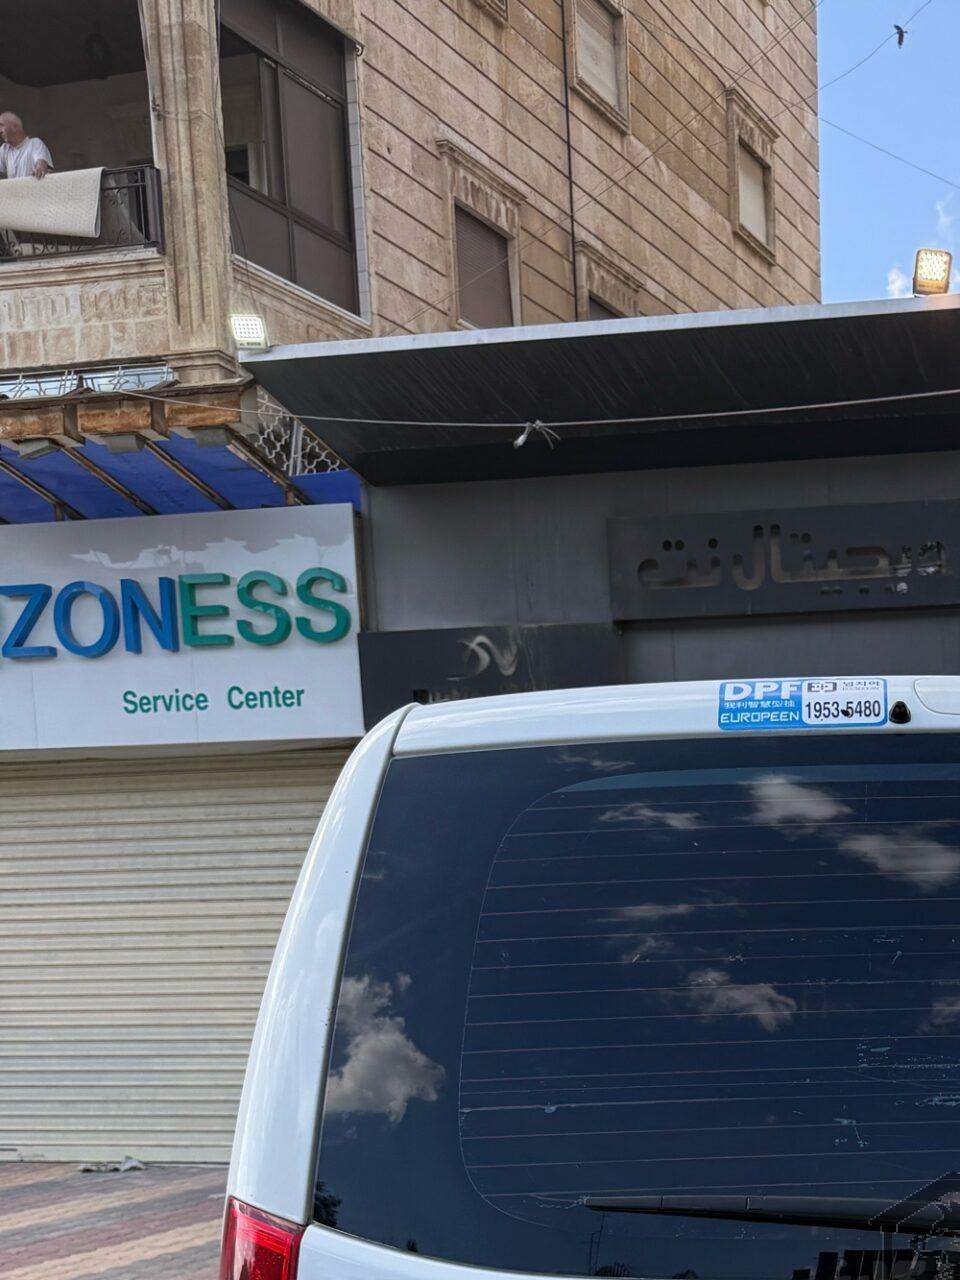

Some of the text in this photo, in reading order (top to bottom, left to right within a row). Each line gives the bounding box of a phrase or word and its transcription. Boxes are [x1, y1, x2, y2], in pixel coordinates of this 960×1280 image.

[0, 566, 351, 661] ZONESS
[122, 685, 305, 714] Service Center
[724, 681, 802, 701] DPF
[720, 711, 800, 724] EUROPEEN
[804, 699, 882, 720] 19535480
